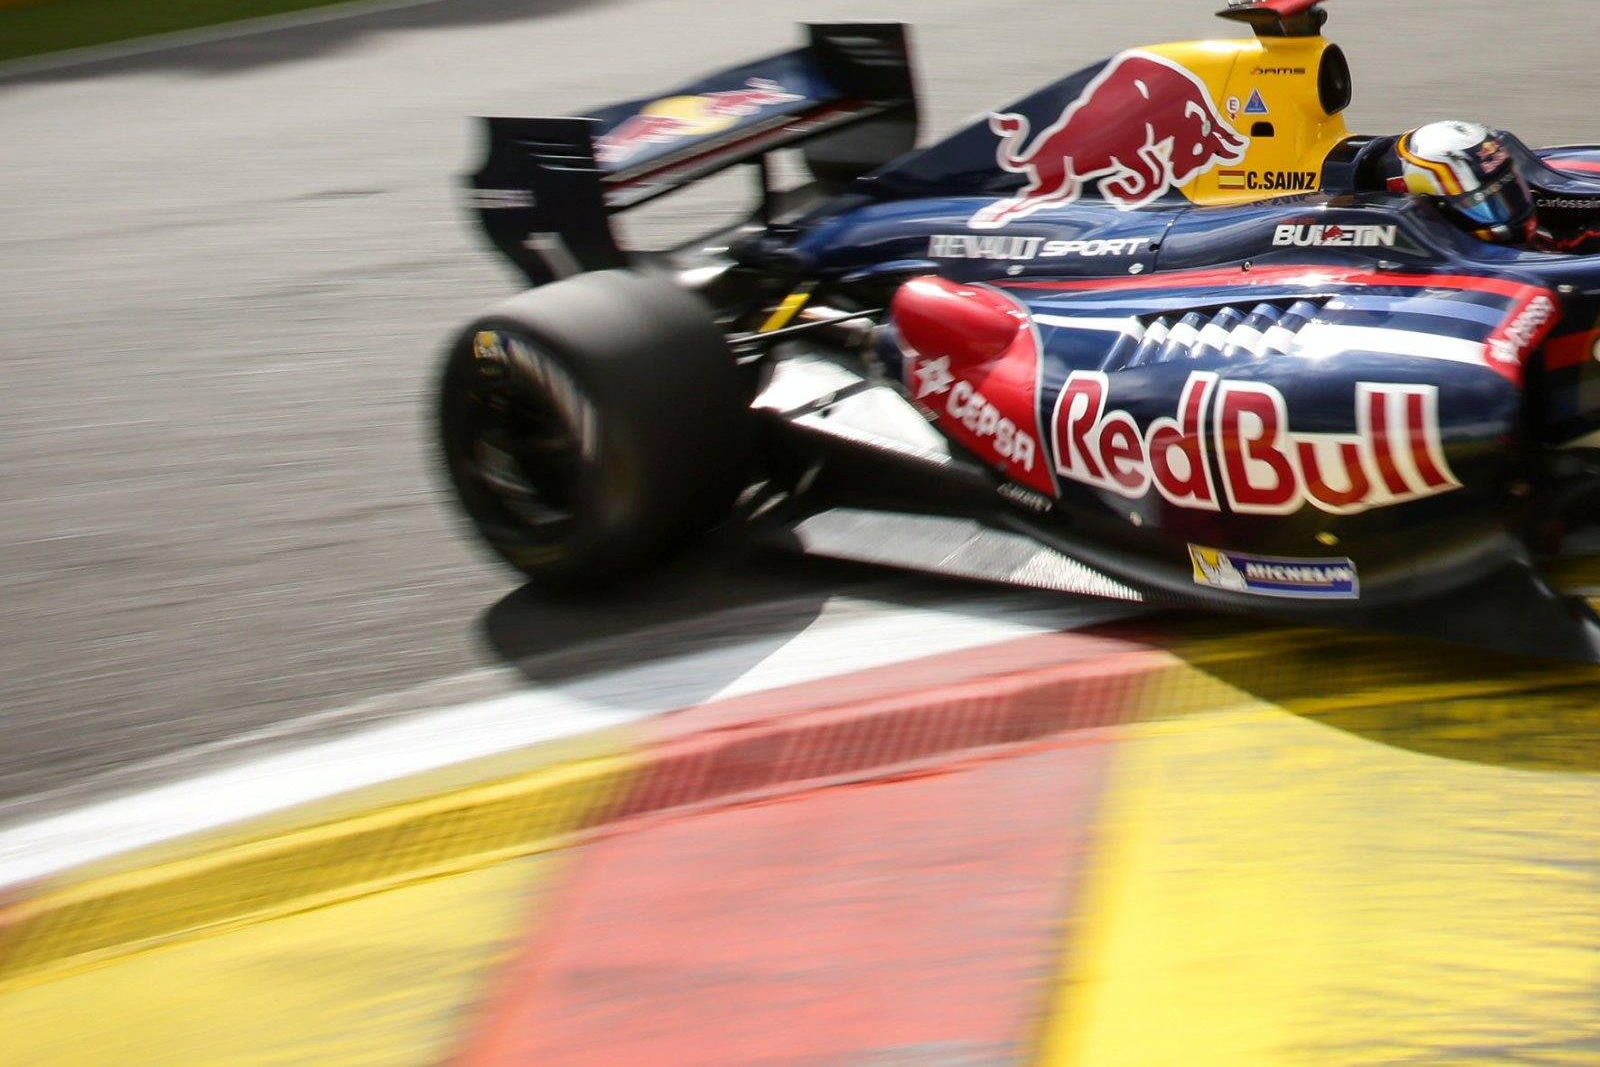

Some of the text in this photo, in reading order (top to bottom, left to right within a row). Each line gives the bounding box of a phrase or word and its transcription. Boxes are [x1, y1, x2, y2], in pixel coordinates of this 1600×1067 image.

[1246, 171, 1316, 189] C.SAINZ
[1271, 224, 1397, 246] BULLETIN
[1039, 237, 1150, 256] SPORT
[946, 380, 1036, 472] CEPSA
[1051, 369, 1464, 515] Red Bull
[1245, 561, 1351, 582] MICHELIN
